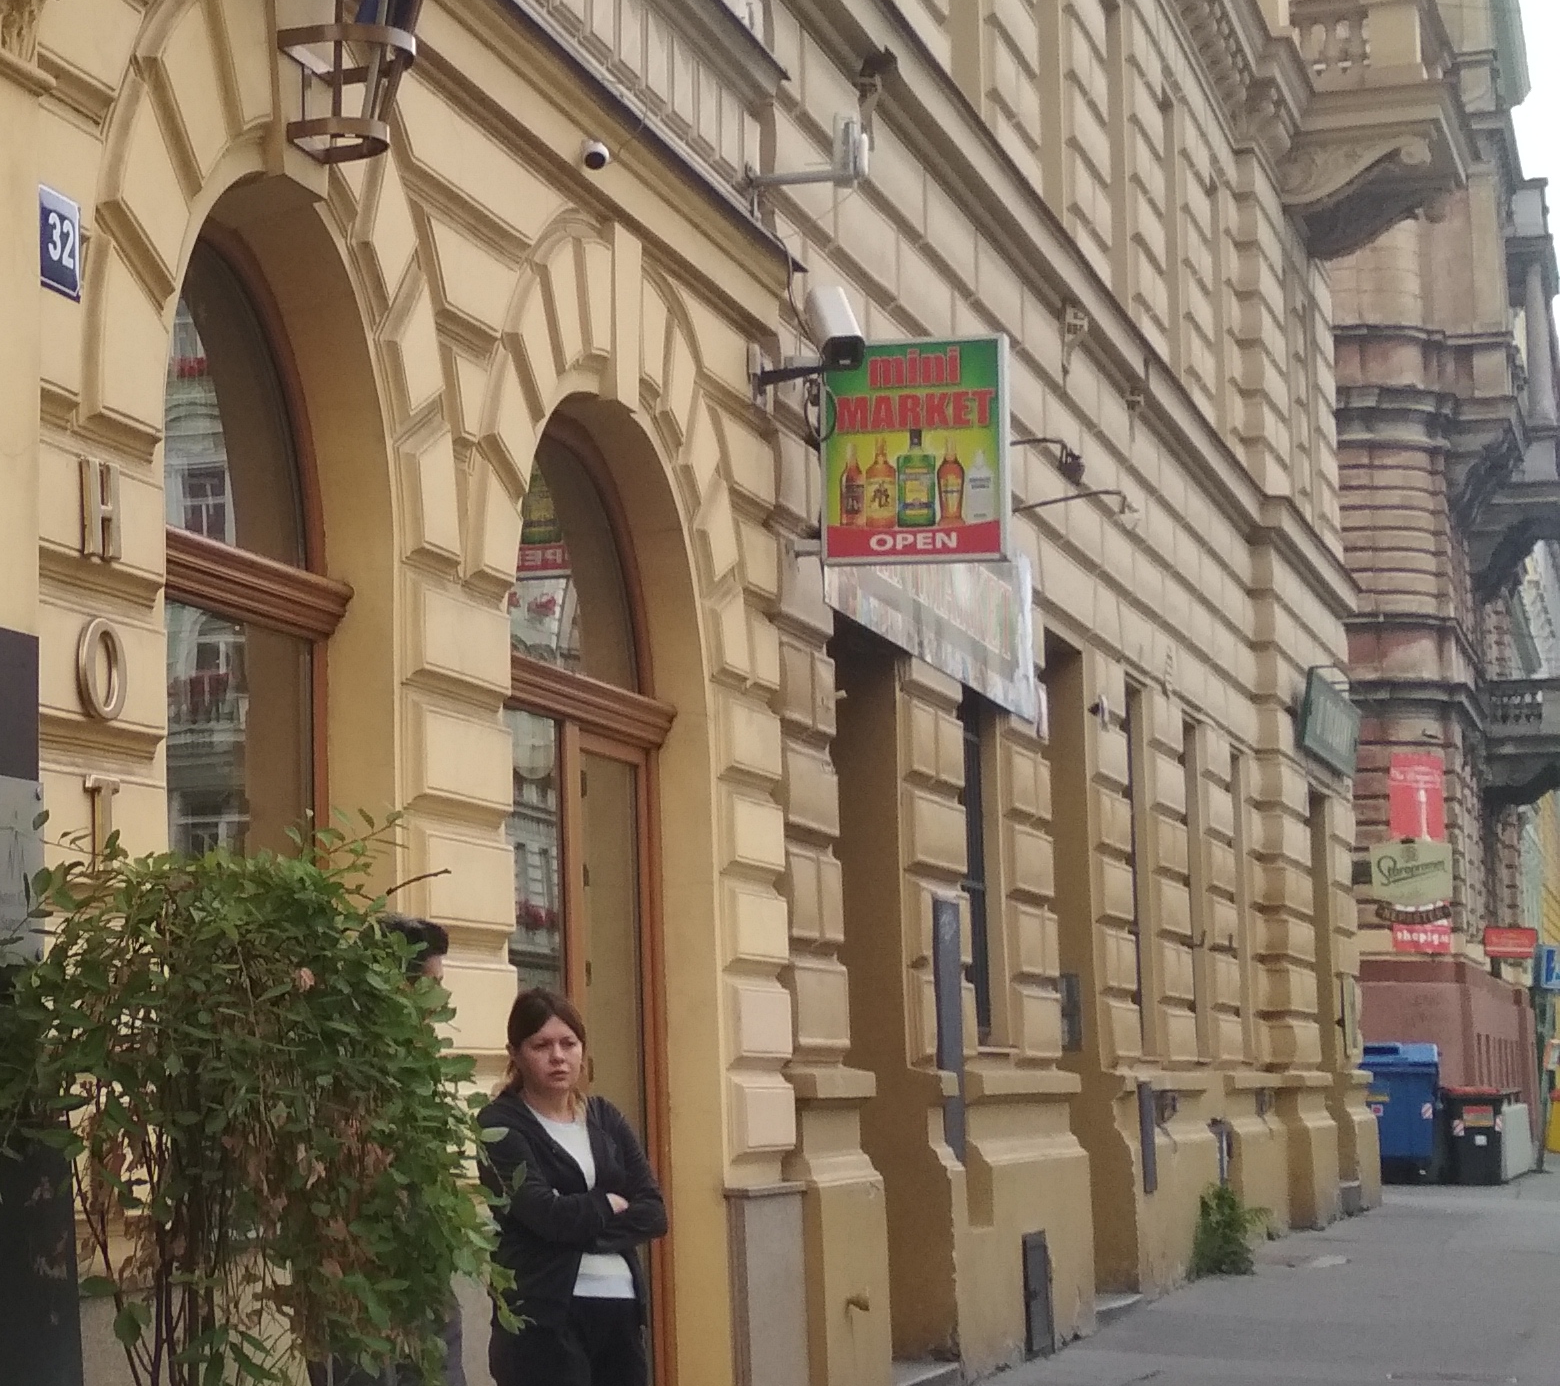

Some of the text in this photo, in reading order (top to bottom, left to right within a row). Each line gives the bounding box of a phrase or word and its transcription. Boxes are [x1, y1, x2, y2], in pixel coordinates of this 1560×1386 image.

[47, 211, 75, 271] 32
[868, 346, 961, 388] mini
[835, 388, 995, 434] MARKET
[869, 531, 958, 552] OPEN
